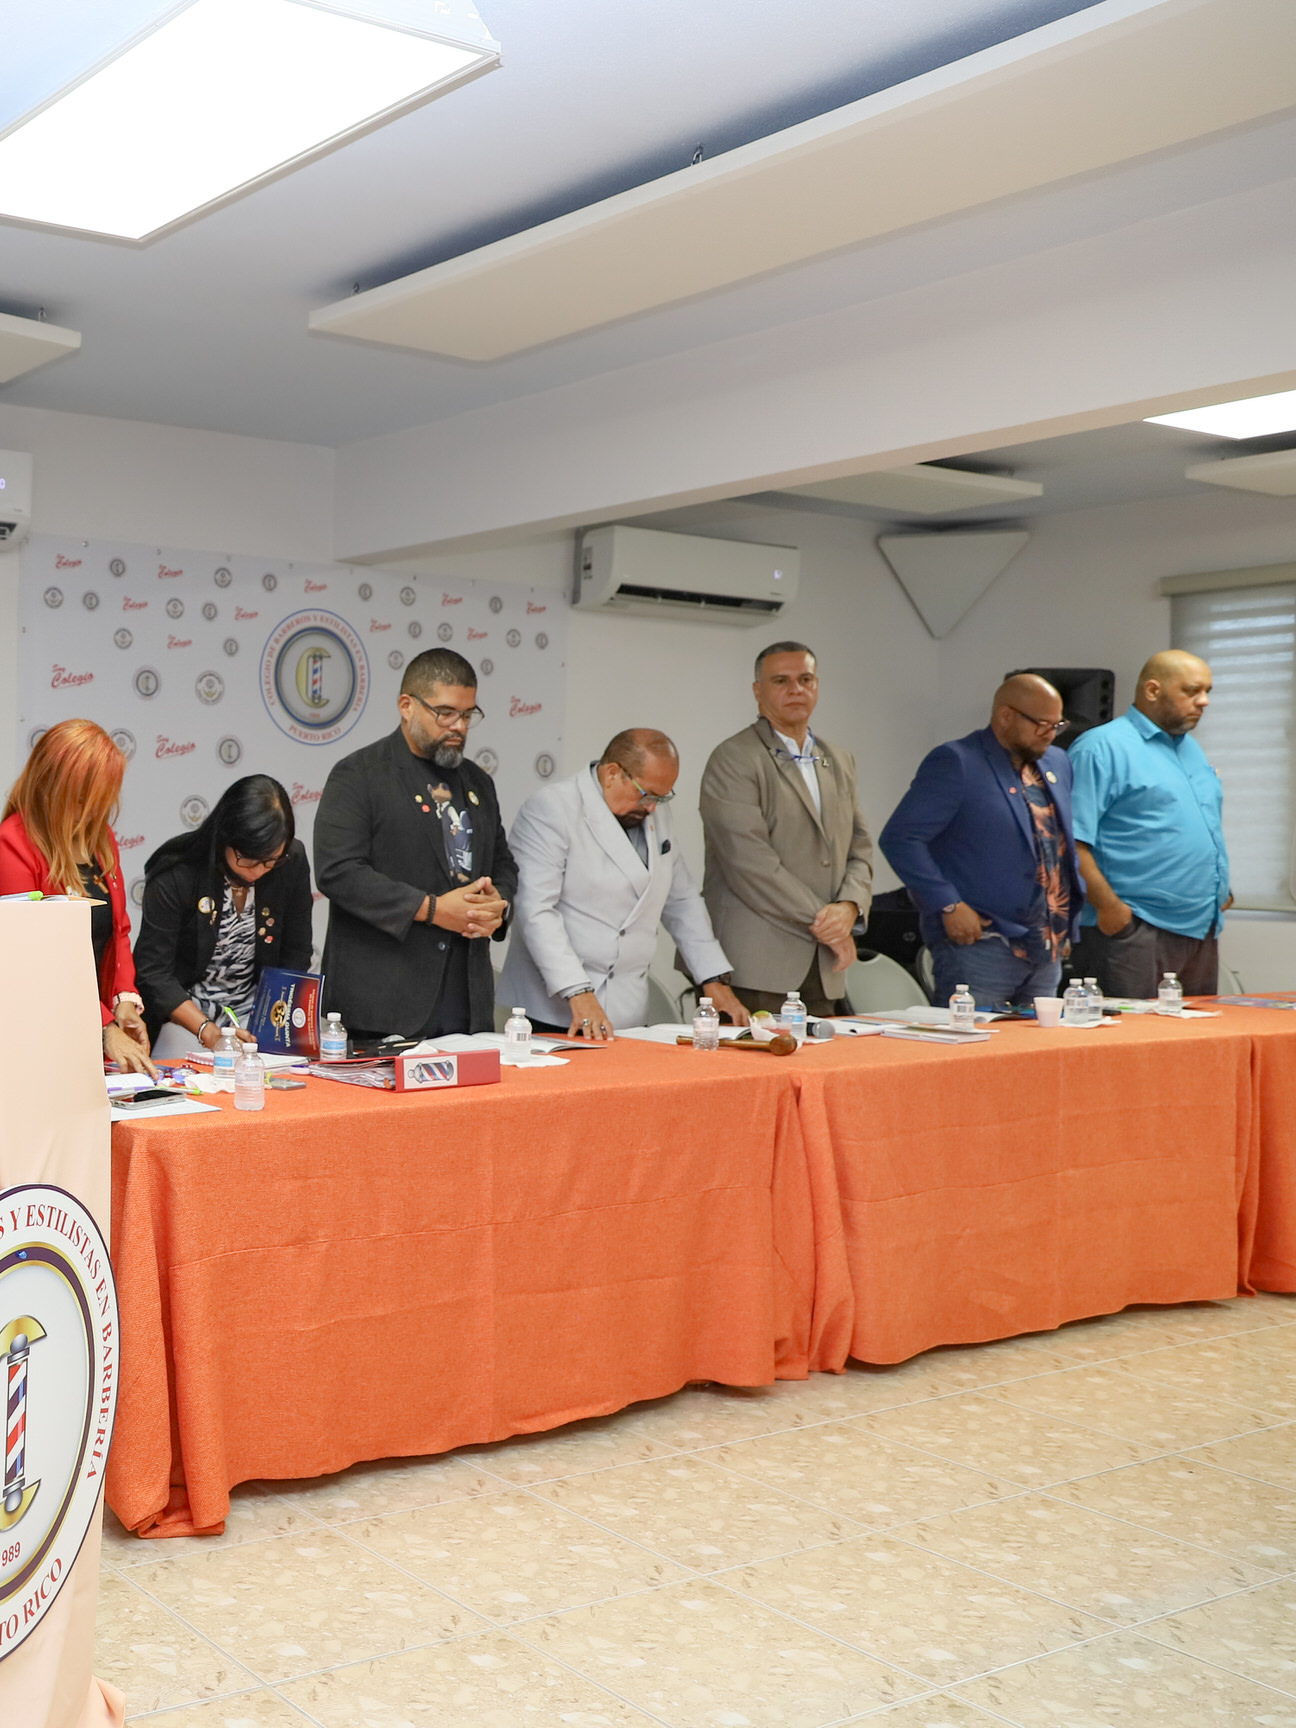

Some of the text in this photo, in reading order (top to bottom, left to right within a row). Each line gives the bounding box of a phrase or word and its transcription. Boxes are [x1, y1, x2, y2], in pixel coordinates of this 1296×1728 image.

[51, 671, 95, 688] Colegio
[289, 724, 342, 741] PUERTO RICO
[155, 741, 196, 759] Colegio
[290, 787, 323, 806] Colegi
[9, 1207, 22, 1232] Y
[25, 1203, 102, 1280] ESTILISTAS
[94, 1278, 111, 1317] EN
[21, 1557, 62, 1626] RICO
